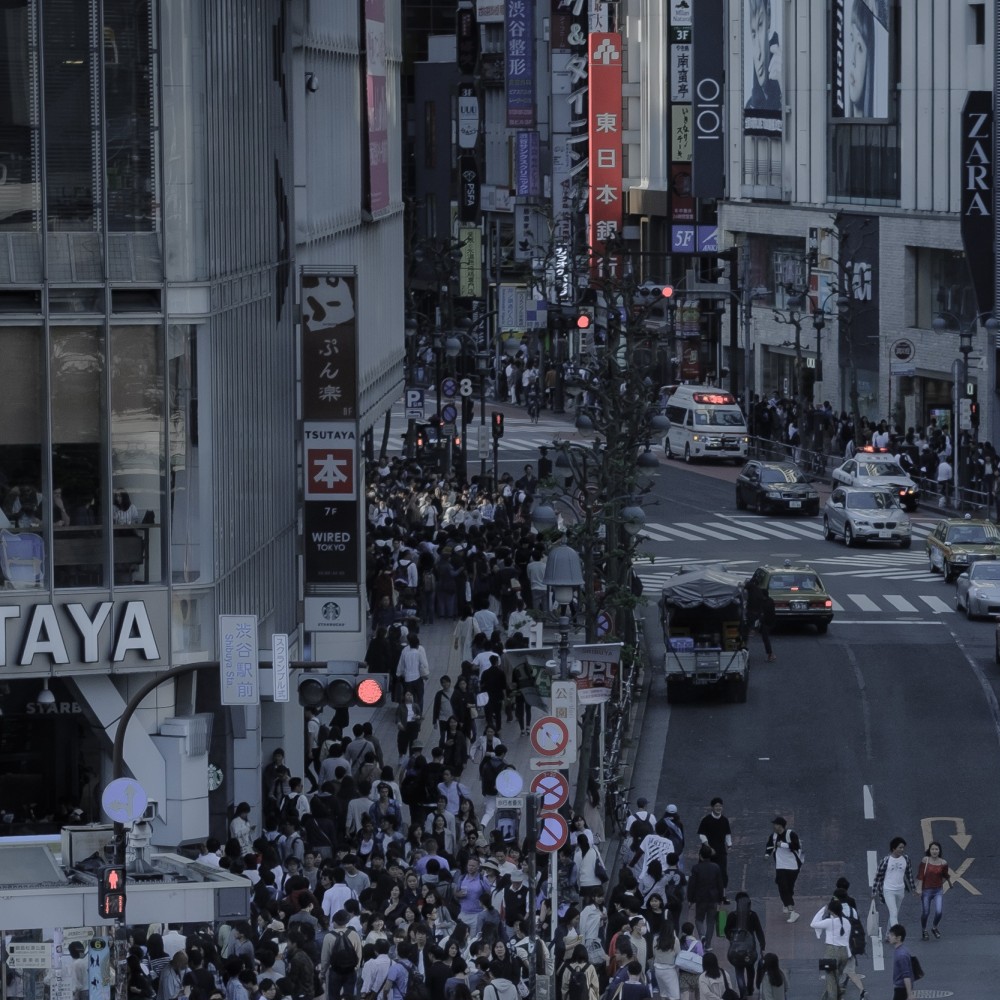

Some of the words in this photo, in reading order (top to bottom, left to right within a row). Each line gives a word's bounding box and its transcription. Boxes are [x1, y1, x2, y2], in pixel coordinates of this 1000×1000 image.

[676, 30, 690, 41] 3F
[965, 113, 991, 216] ZARA
[674, 230, 694, 247] 5F
[459, 378, 473, 397] 8
[408, 390, 421, 407] P
[305, 430, 355, 440] TSUTAYA
[312, 453, 349, 490] 本
[324, 506, 338, 516] 7F
[312, 532, 351, 543] WIRED
[317, 543, 346, 552] TOKYO
[224, 633, 235, 669] Shibuya
[235, 622, 254, 698] 渋谷駅前
[276, 637, 287, 698] スクランブル式
[225, 670, 234, 688] Sta.
